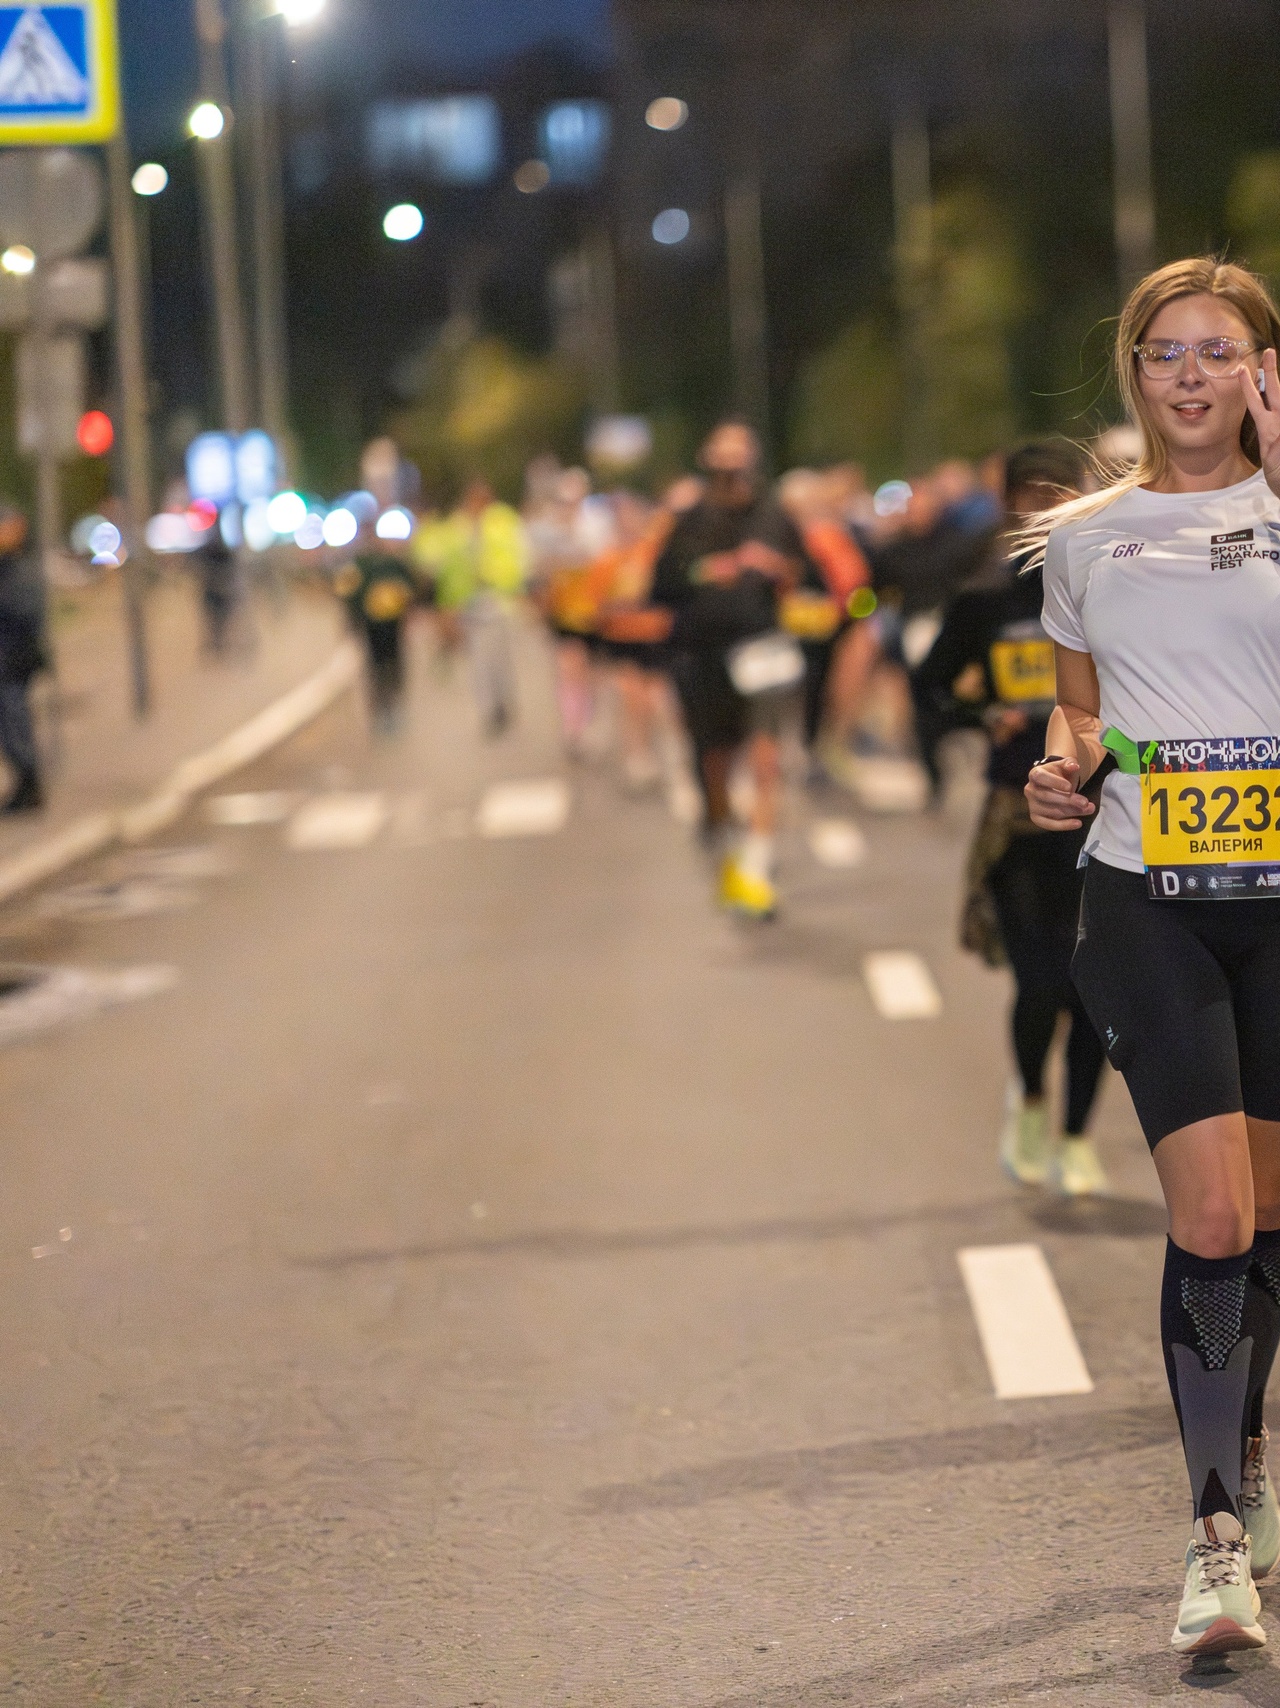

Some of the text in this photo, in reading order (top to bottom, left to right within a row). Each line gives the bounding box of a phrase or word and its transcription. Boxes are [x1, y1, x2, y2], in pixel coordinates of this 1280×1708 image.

[1210, 543, 1255, 556] SPORT
[1211, 559, 1244, 571] FEST
[1223, 763, 1273, 772] ЗАБЕГ
[1189, 837, 1264, 854] ВАЛЕРИЯ
[1161, 871, 1180, 896] D
